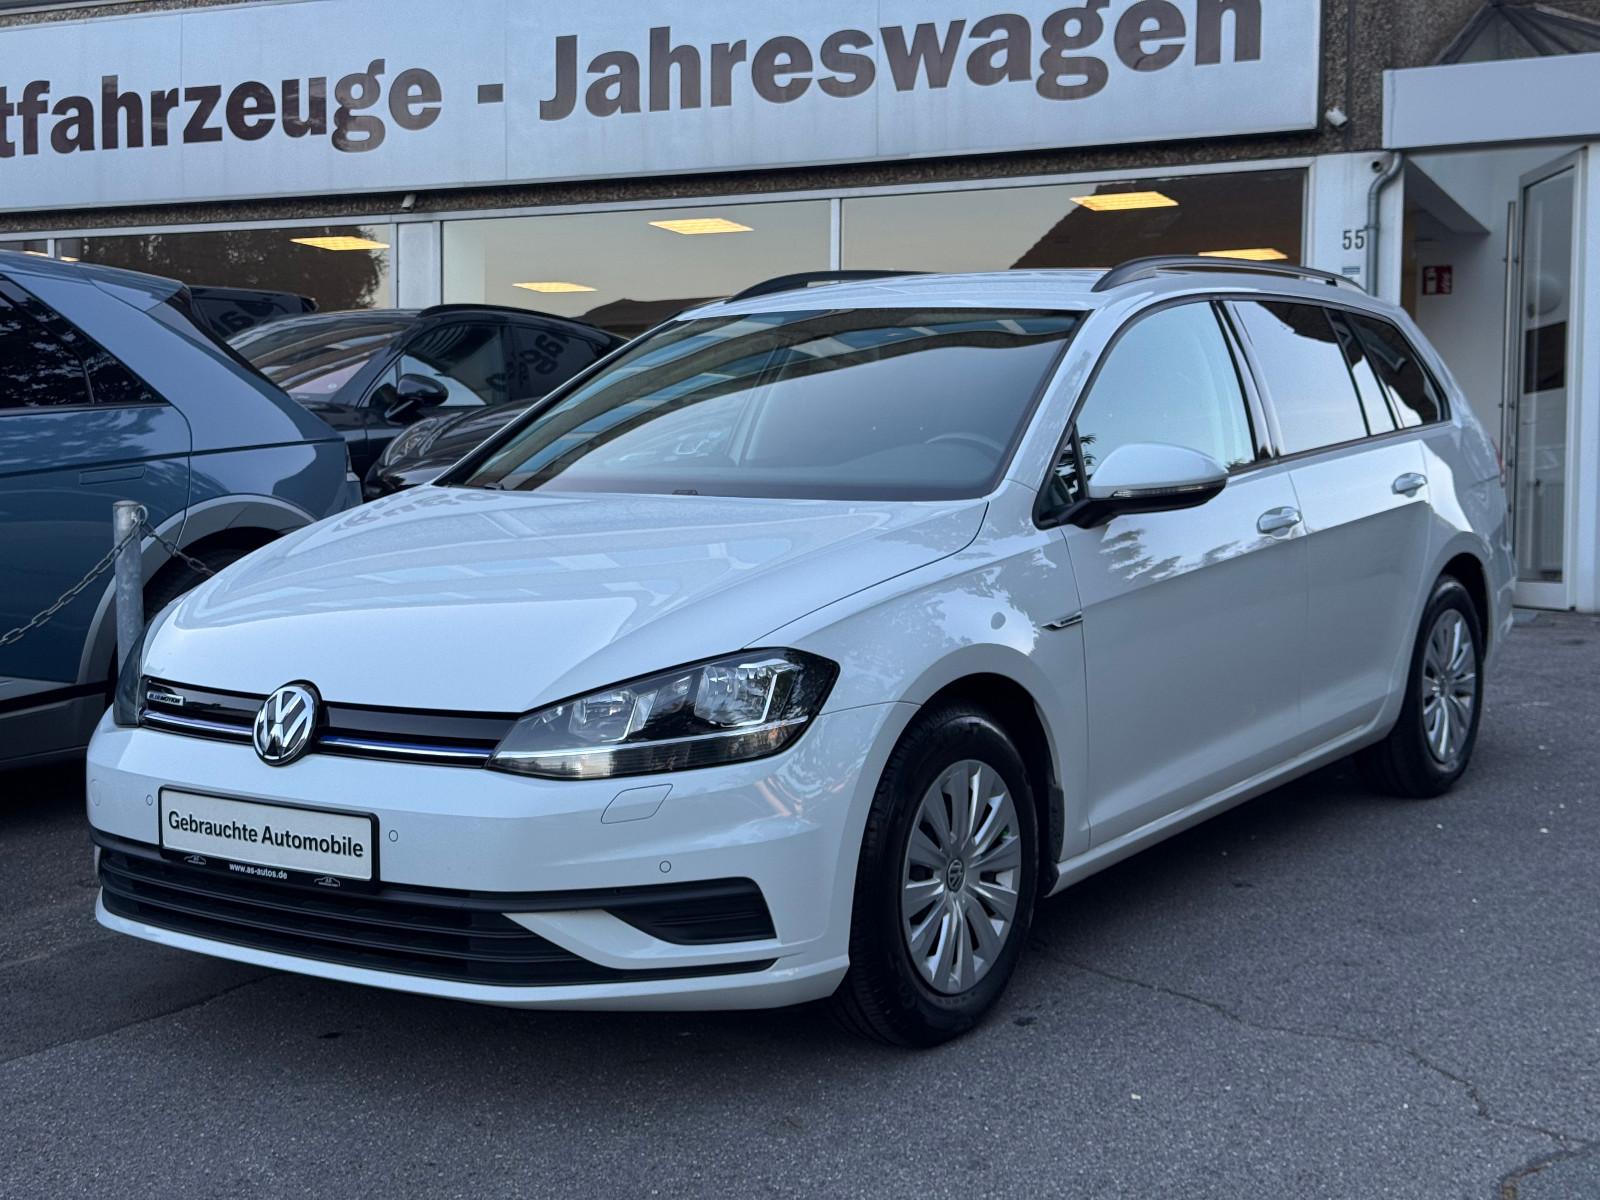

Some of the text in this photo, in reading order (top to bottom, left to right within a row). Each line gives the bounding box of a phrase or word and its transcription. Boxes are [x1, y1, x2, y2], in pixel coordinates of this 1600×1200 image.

[539, 0, 1262, 121] Jahreswagen
[1342, 229, 1365, 250] 55
[168, 810, 364, 858] Gebrauchte Automobile
[229, 862, 288, 880] www.as-autos.de
